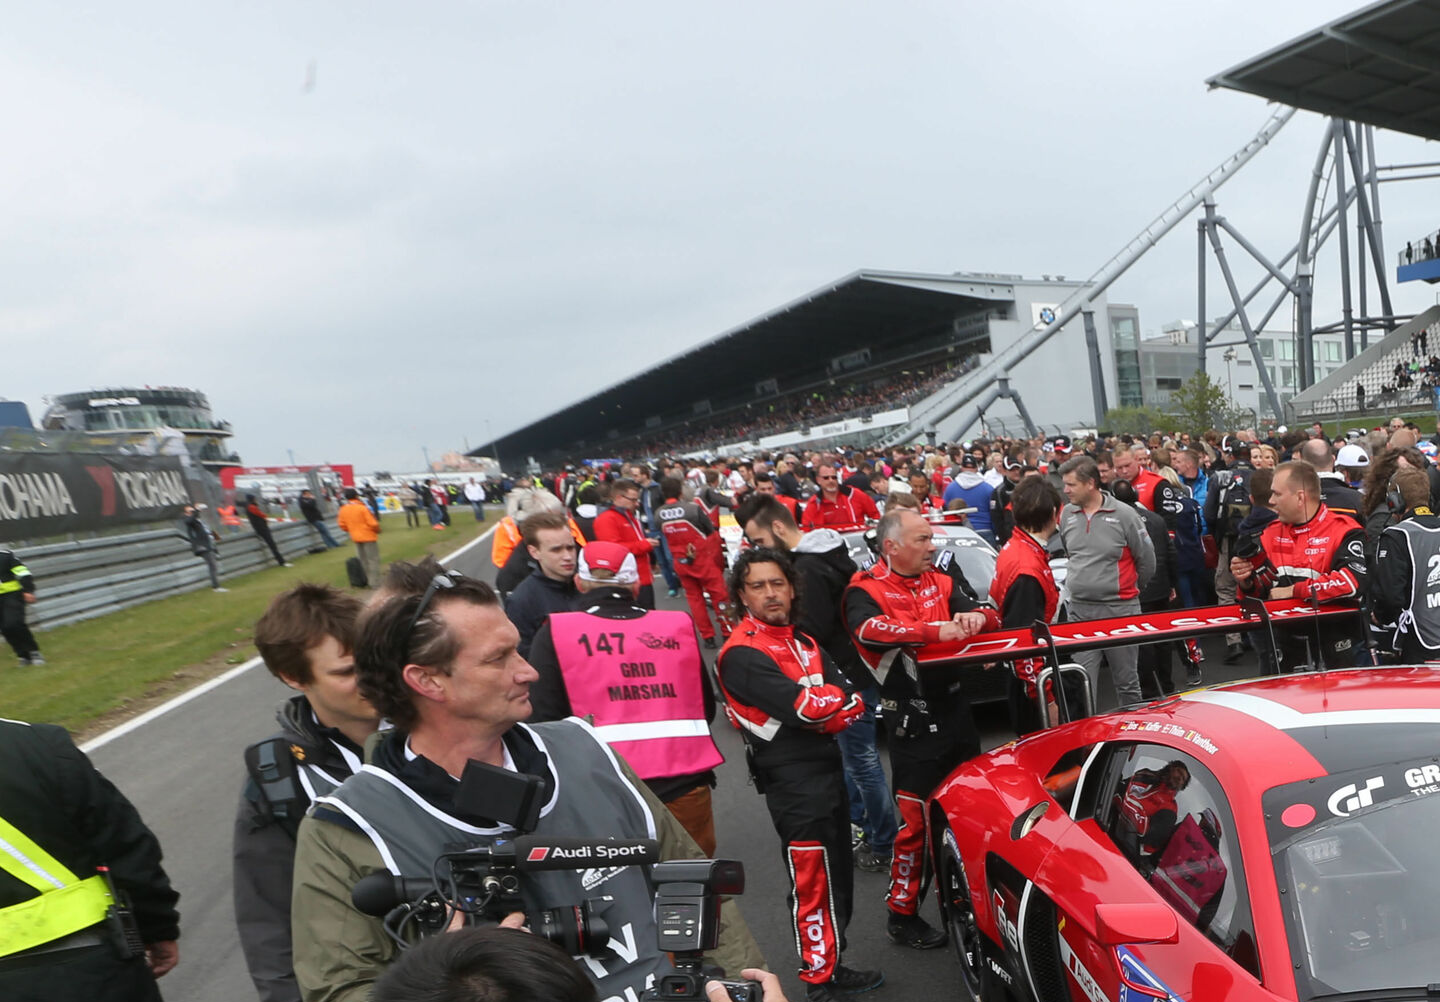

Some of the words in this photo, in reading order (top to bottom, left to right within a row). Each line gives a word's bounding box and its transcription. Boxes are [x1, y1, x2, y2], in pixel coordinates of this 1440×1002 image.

[112, 470, 190, 509] YOKOHAMA
[578, 633, 625, 656] 147
[620, 662, 657, 678] GRID
[608, 683, 678, 701] MARSHAL
[551, 846, 592, 858] Audi
[596, 844, 646, 859] Sport
